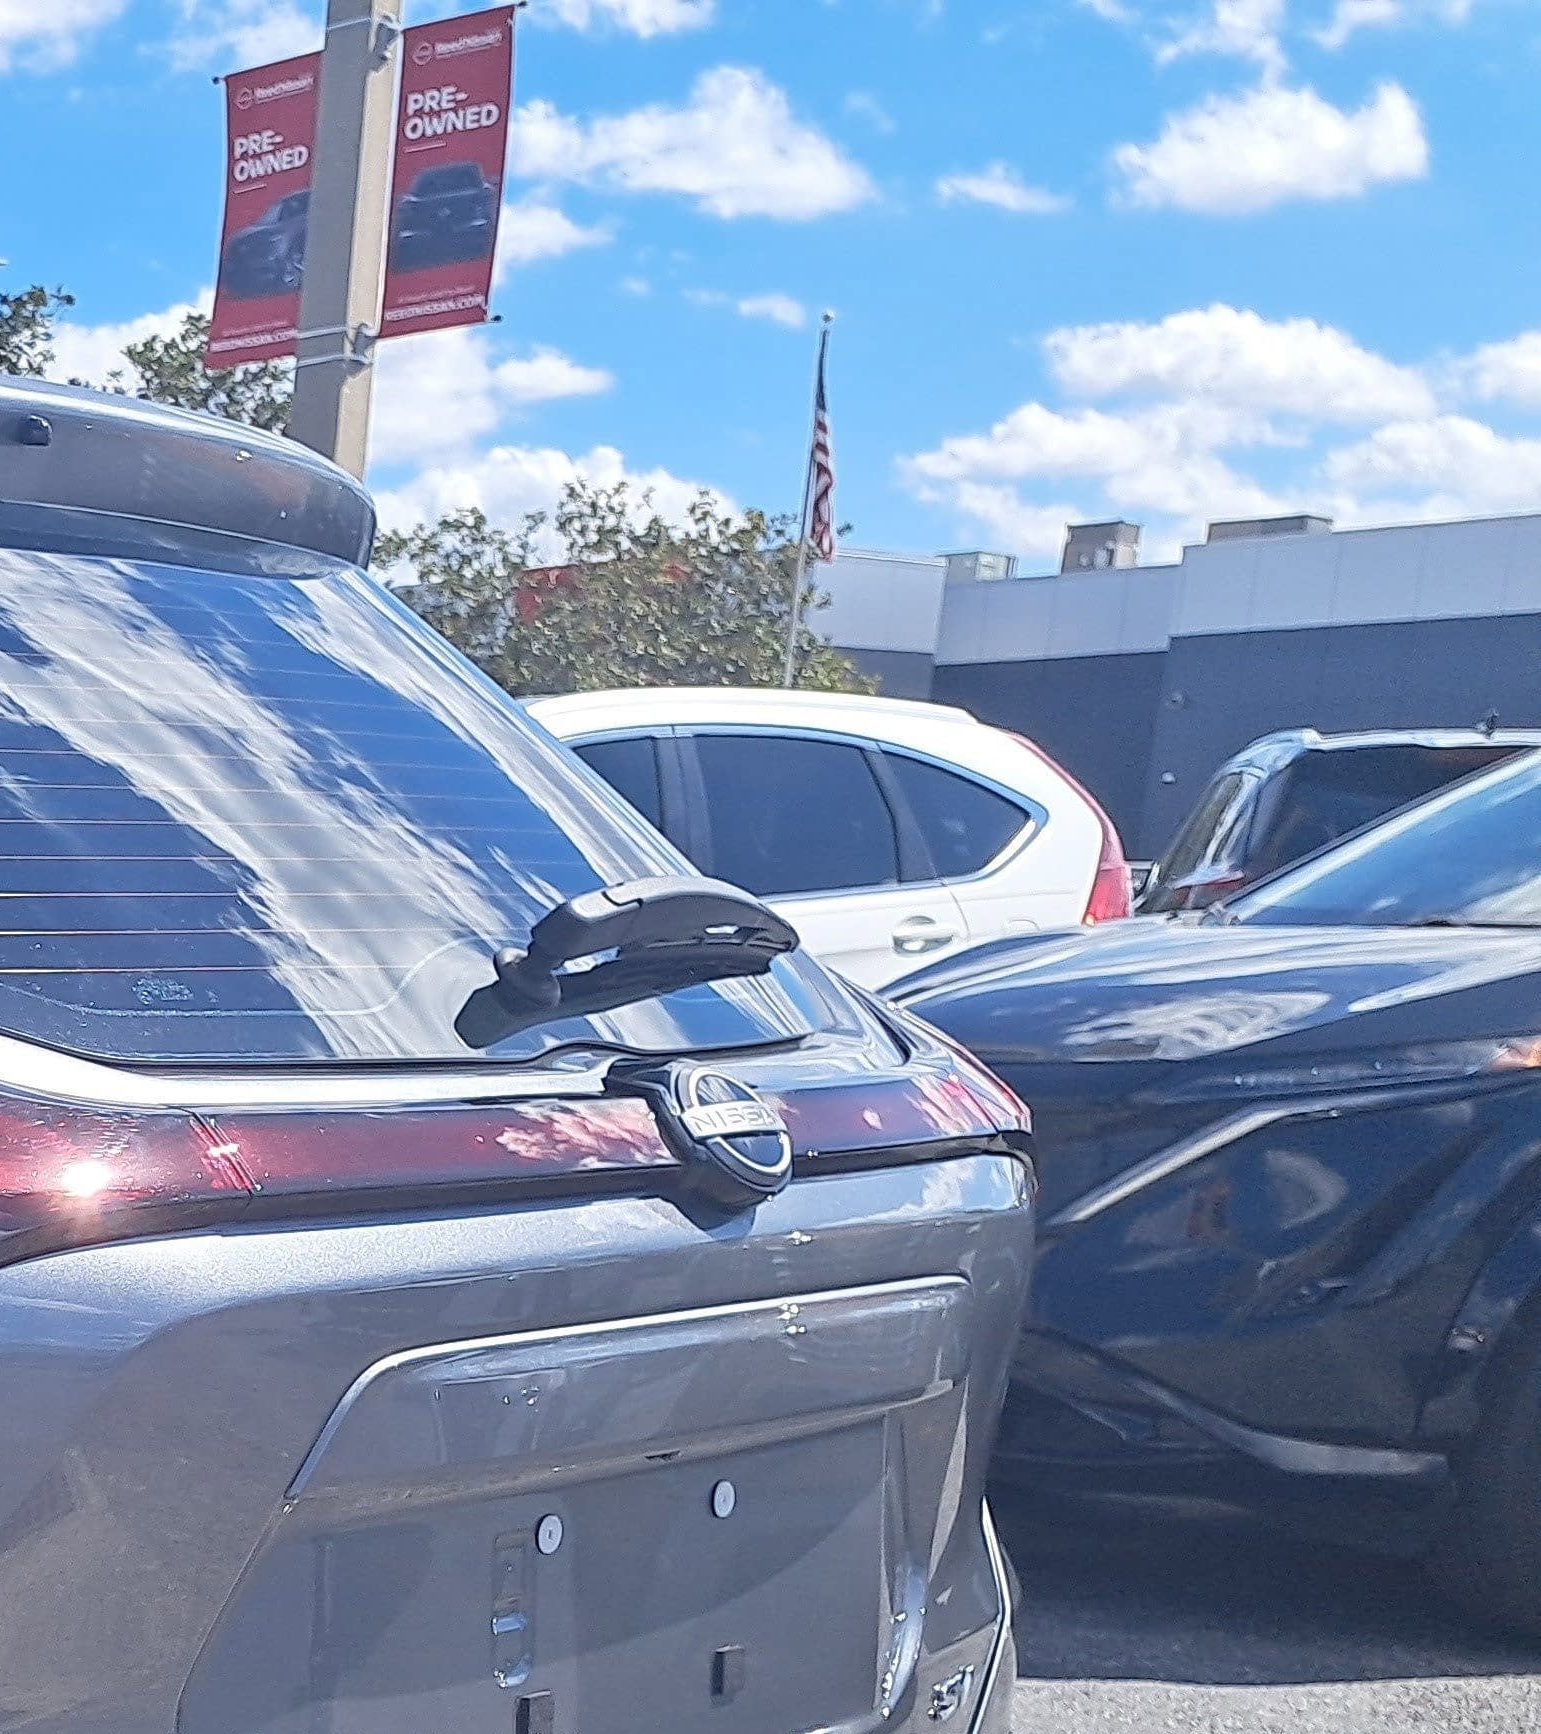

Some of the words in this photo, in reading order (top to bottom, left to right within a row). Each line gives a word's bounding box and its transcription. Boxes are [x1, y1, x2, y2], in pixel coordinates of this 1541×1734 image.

[406, 86, 469, 117] PRE-
[404, 104, 499, 141] OWNED
[233, 130, 284, 160] PRE-
[232, 146, 309, 182] OWNED
